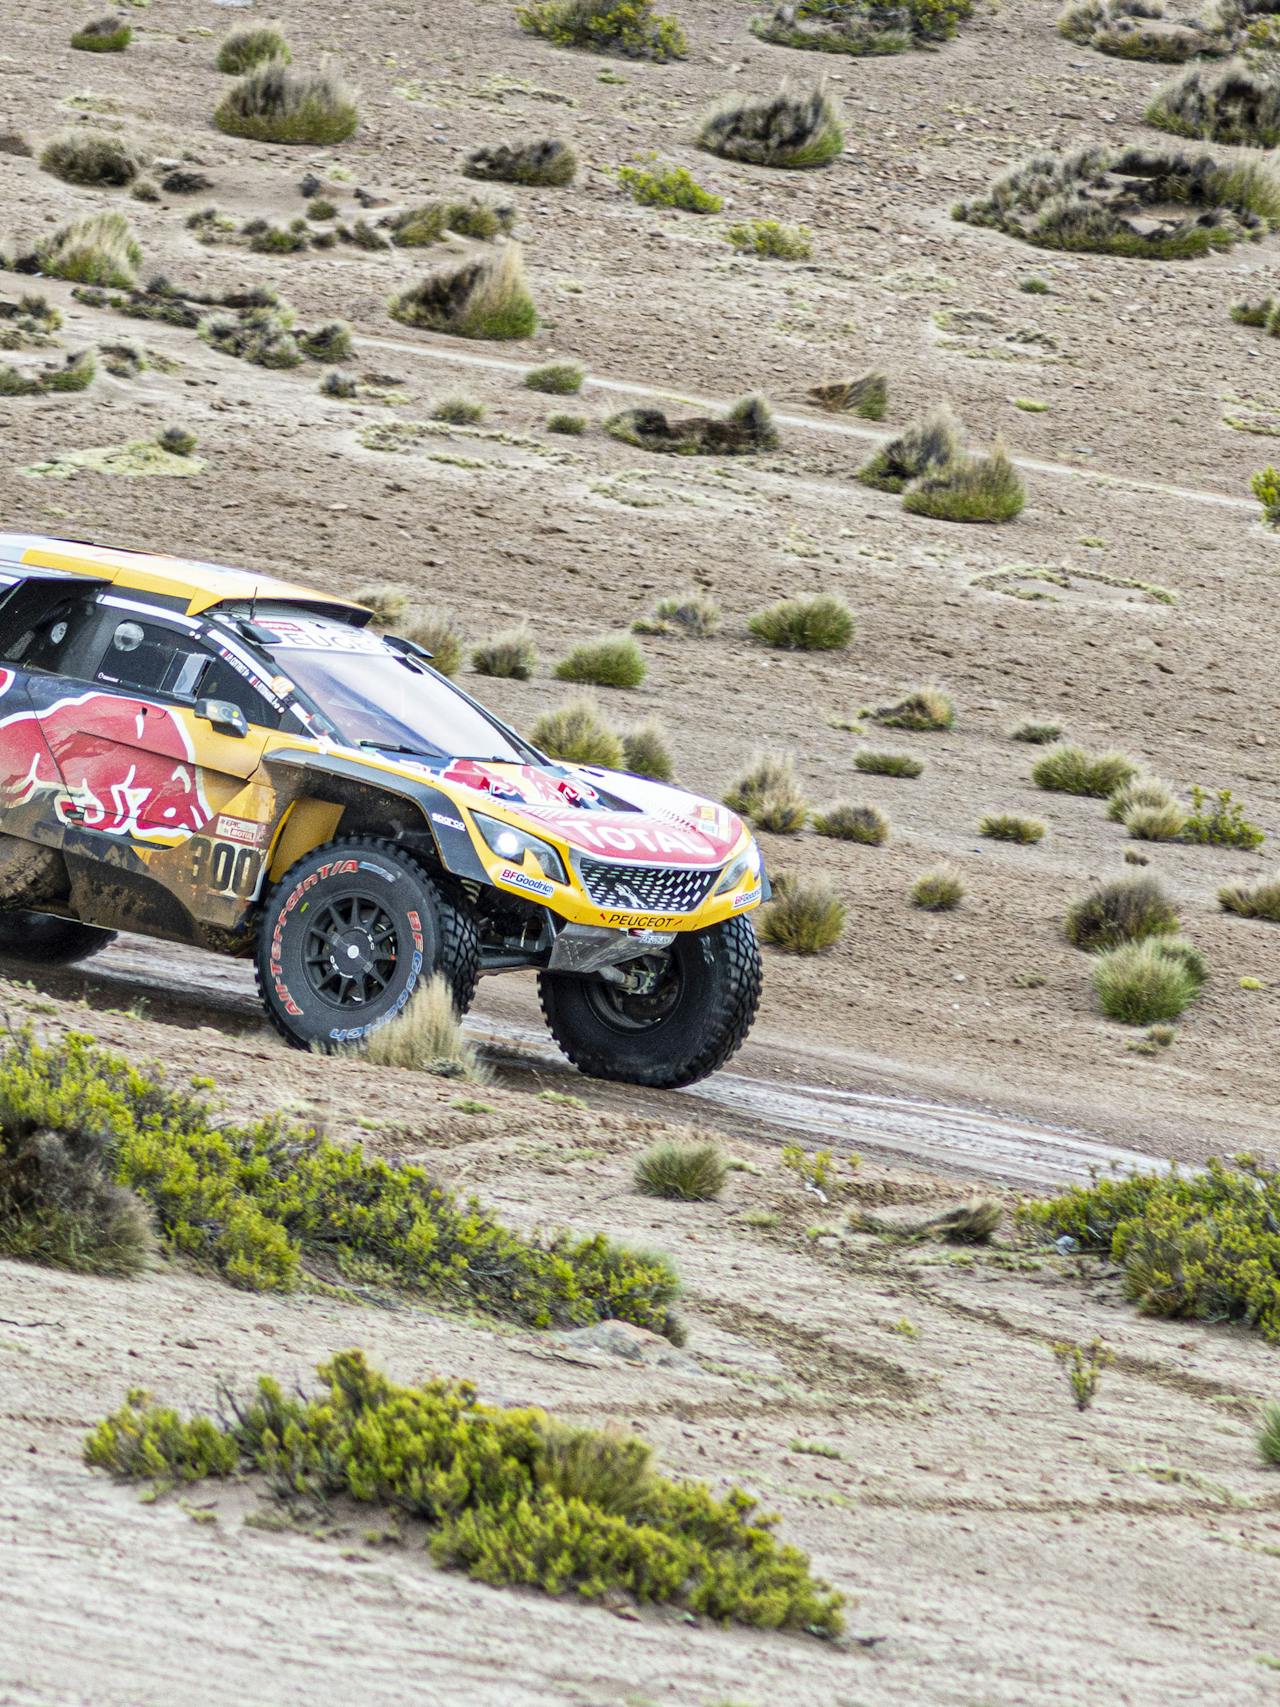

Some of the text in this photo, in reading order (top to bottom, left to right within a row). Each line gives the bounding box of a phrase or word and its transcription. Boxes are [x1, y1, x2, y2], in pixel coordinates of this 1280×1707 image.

[556, 819, 717, 856] TOTAL
[185, 836, 261, 897] 300
[502, 868, 554, 893] BFGoodrich
[608, 914, 675, 928] PEUGEOT
